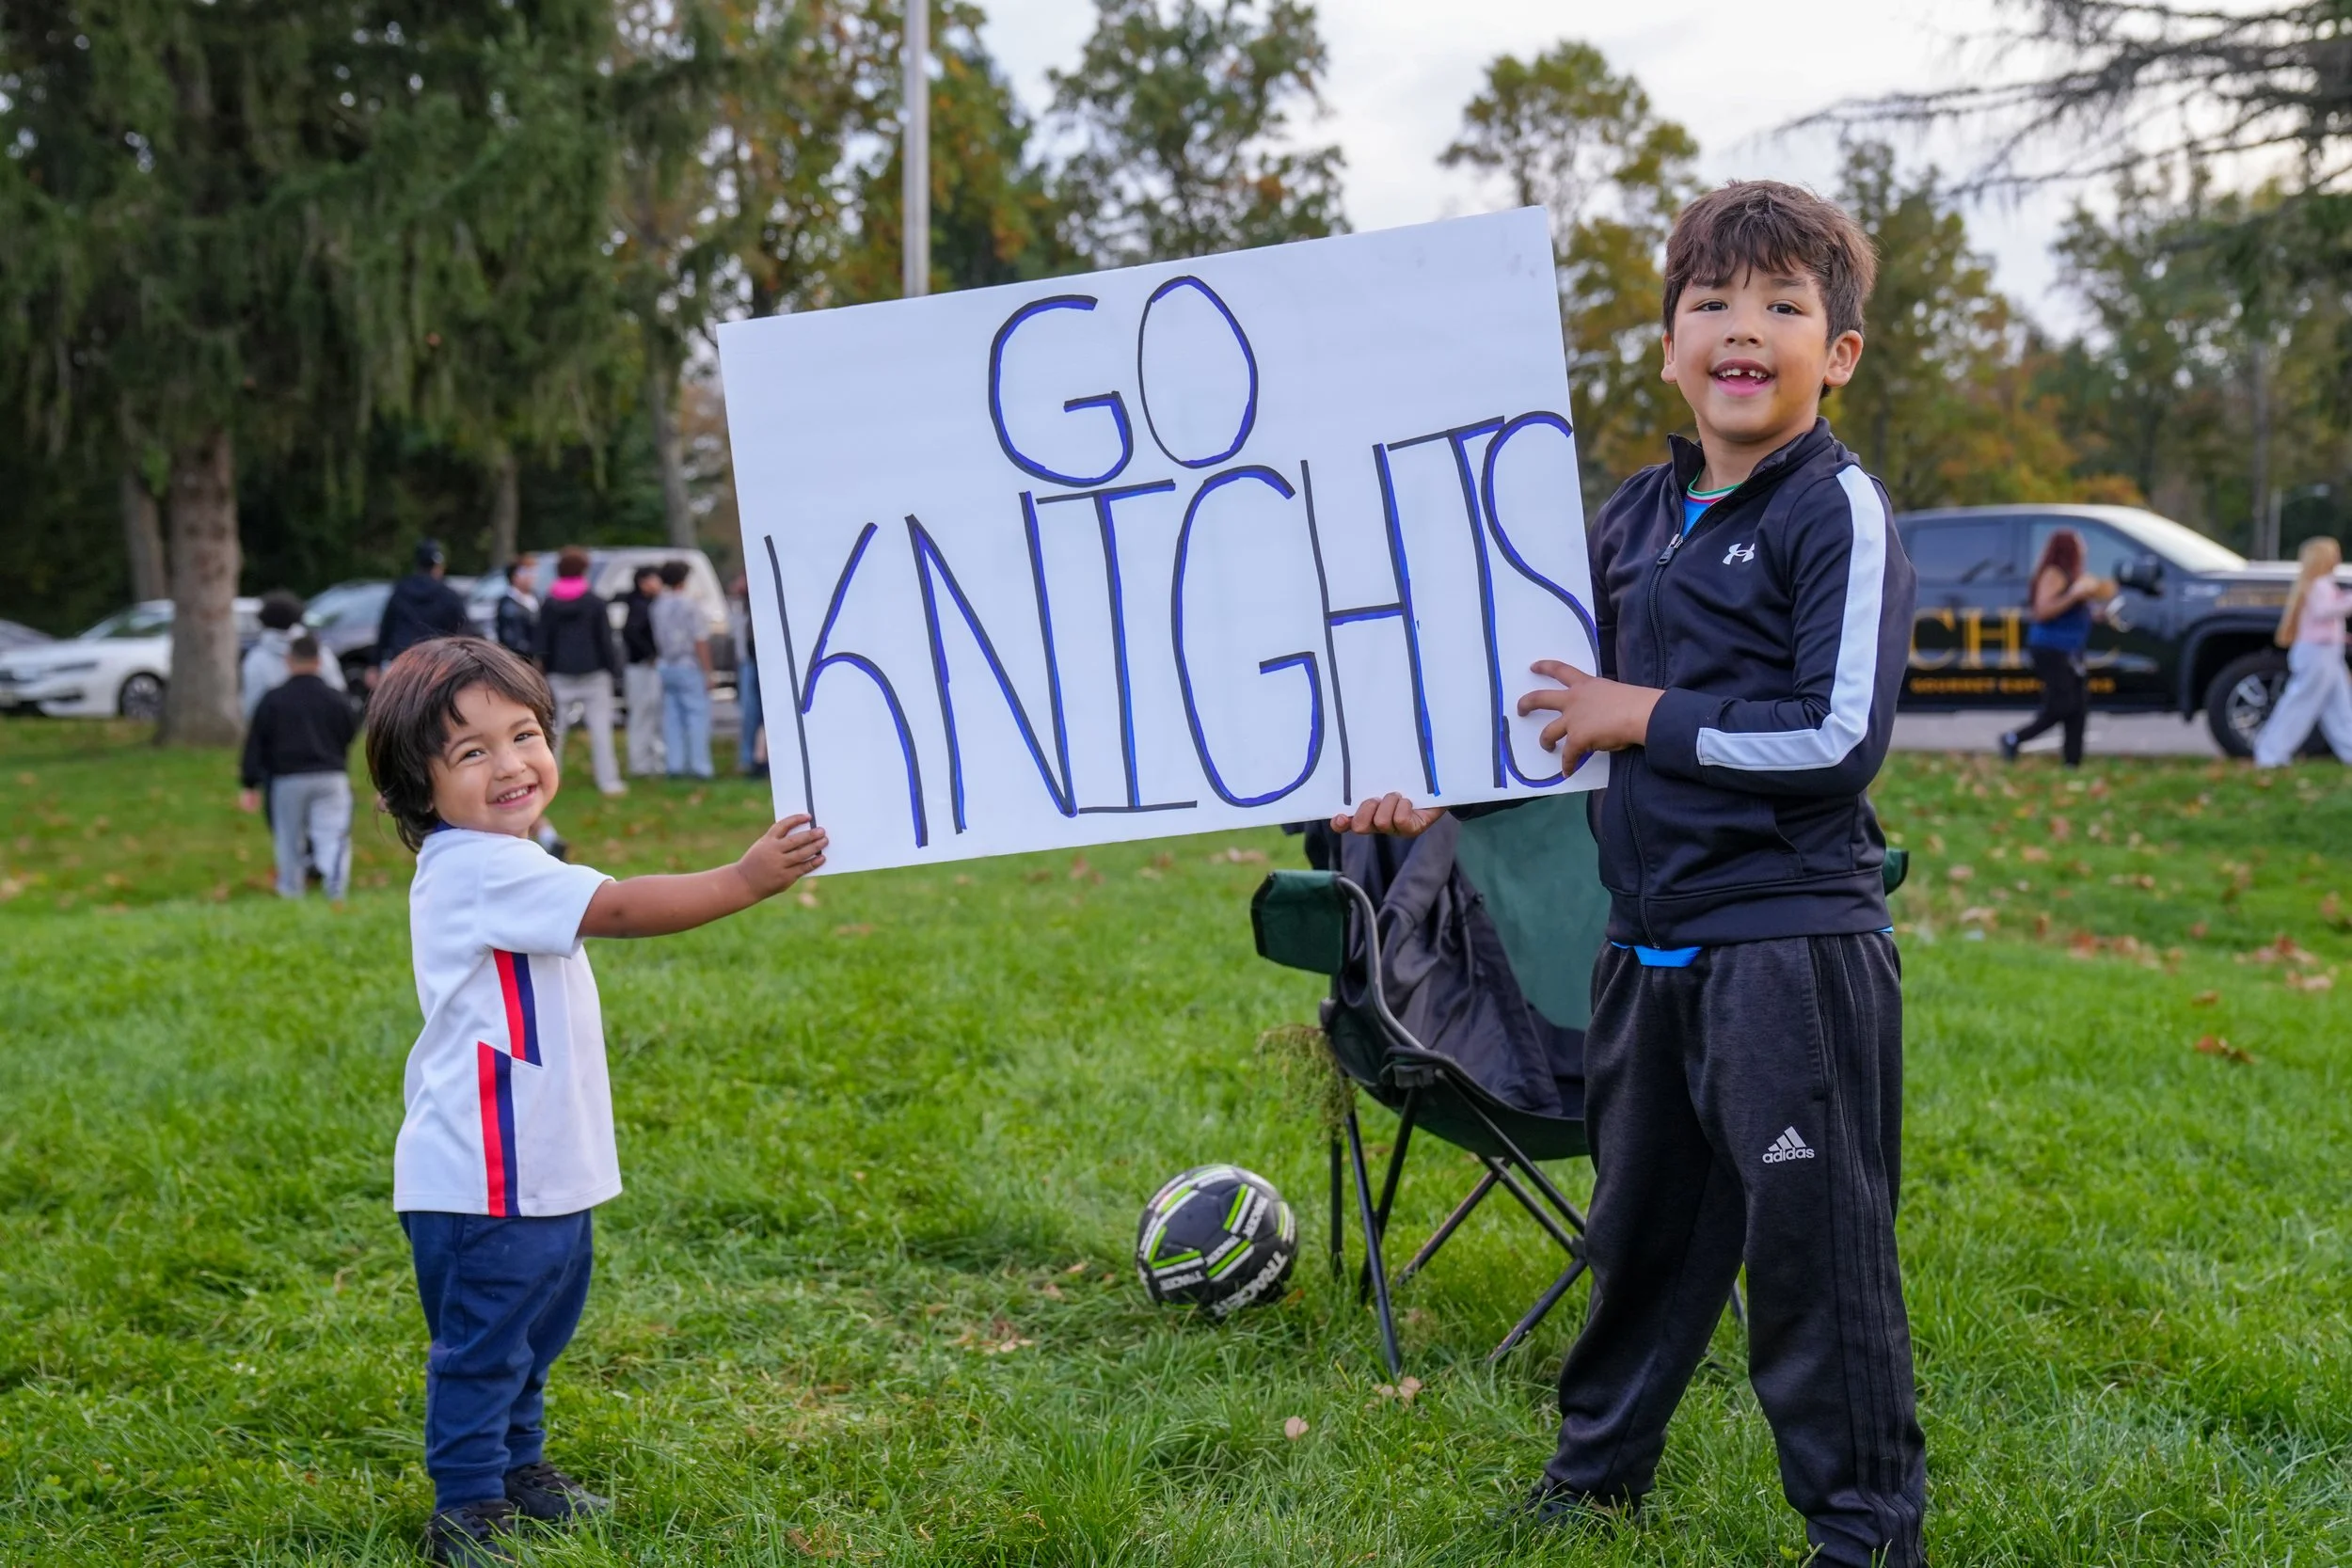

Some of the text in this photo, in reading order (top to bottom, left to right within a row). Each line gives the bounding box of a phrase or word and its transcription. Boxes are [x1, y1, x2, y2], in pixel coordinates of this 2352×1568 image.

[989, 275, 1258, 486] GO
[764, 411, 1601, 855] KNIGHTS
[1762, 1148, 1815, 1164] adidas
[1213, 1250, 1288, 1316] TRACER
